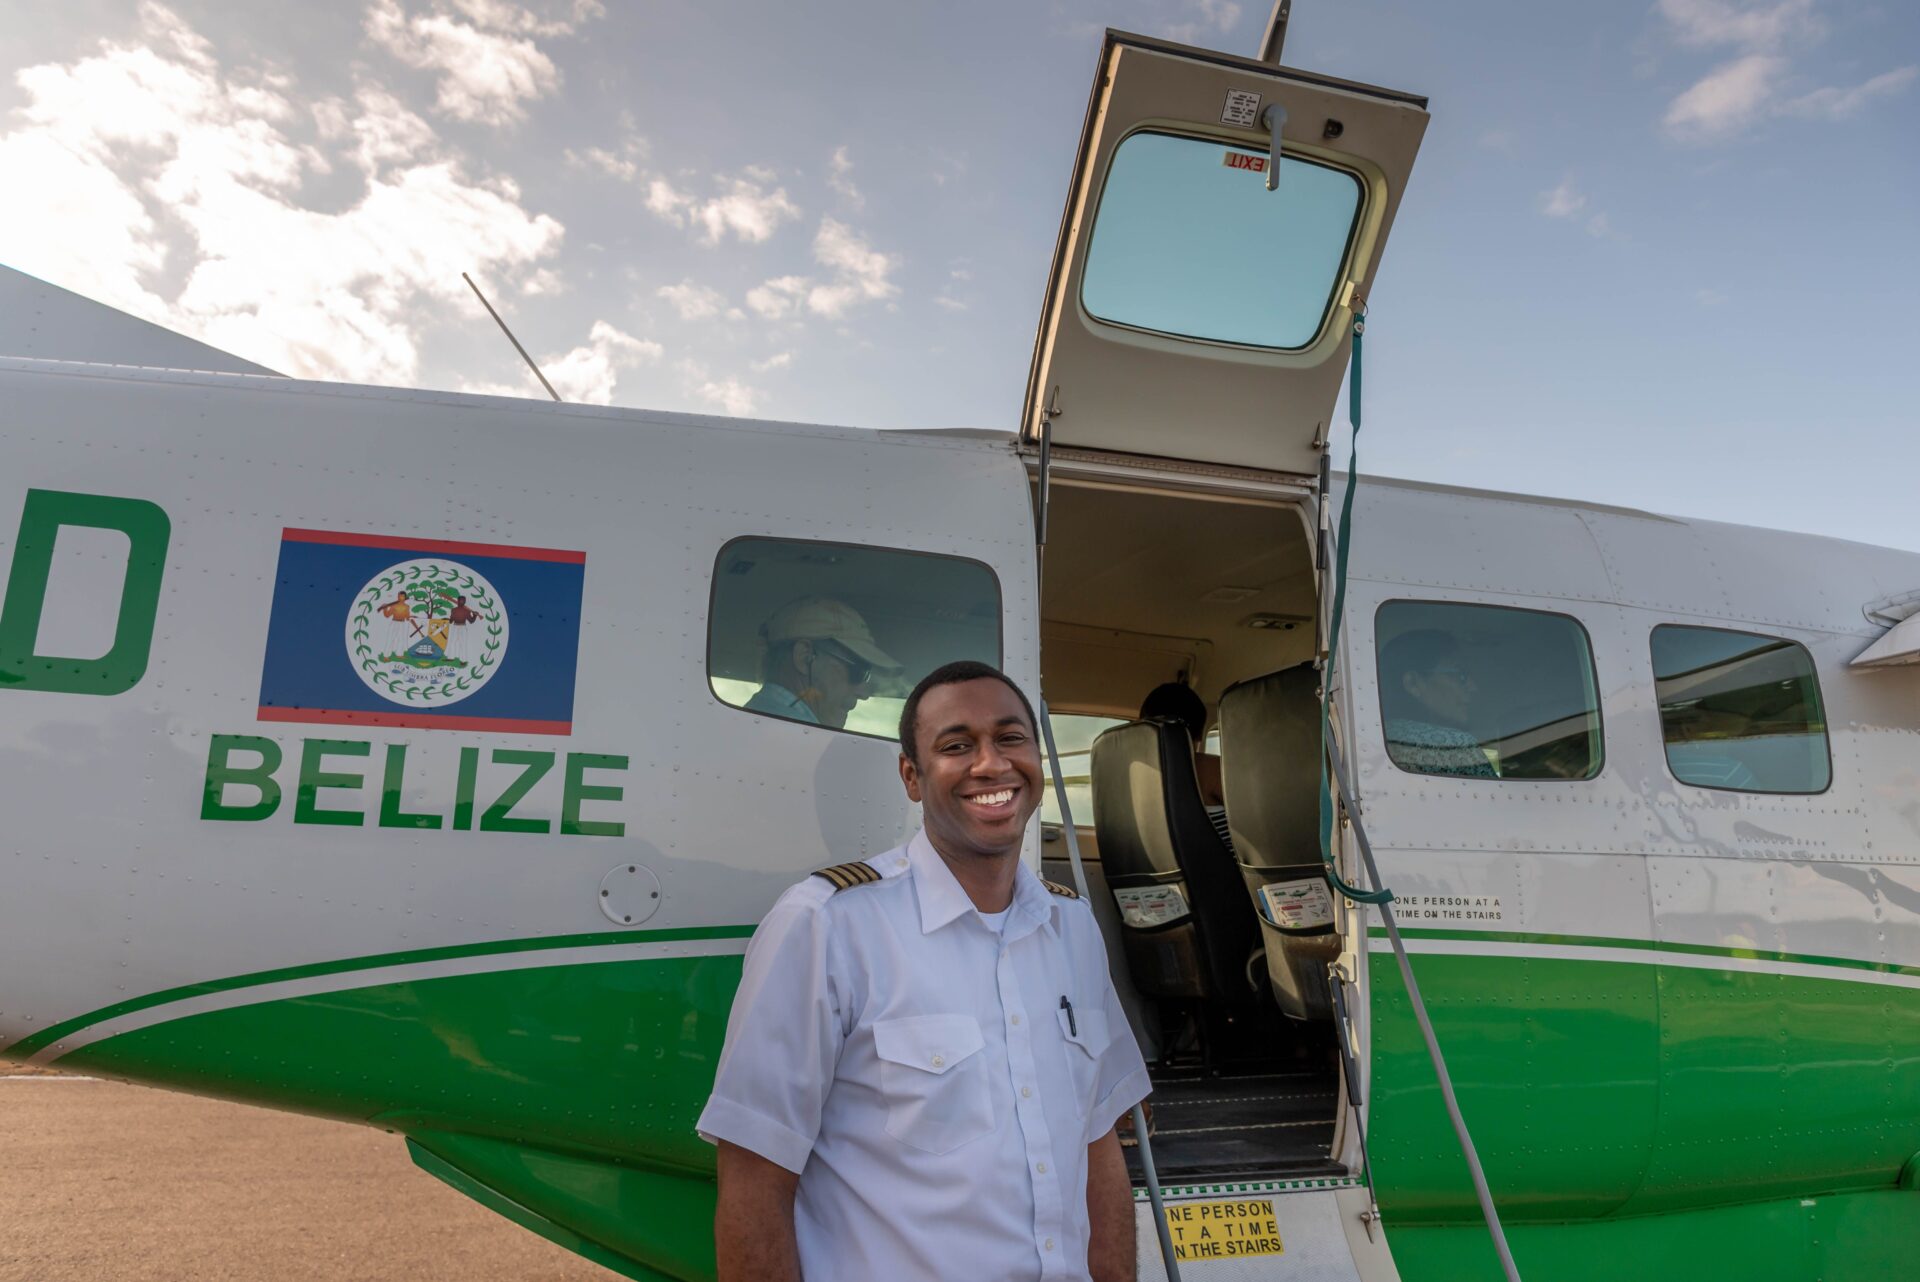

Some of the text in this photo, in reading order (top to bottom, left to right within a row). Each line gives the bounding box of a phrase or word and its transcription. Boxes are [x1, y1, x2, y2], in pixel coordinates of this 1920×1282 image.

[1227, 153, 1265, 172] EXIT
[0, 488, 171, 696] D
[200, 734, 629, 837] BELIZE
[1394, 896, 1417, 905] ONE
[1424, 897, 1470, 906] PERSON
[1476, 898, 1488, 907] AT
[1395, 910, 1502, 920] TIME ON THE STAIRS
[1167, 1202, 1273, 1222] NE PERSON
[1201, 1225, 1212, 1239] A
[1224, 1220, 1277, 1238] TIME
[1174, 1238, 1282, 1259] N THE STAIRS
